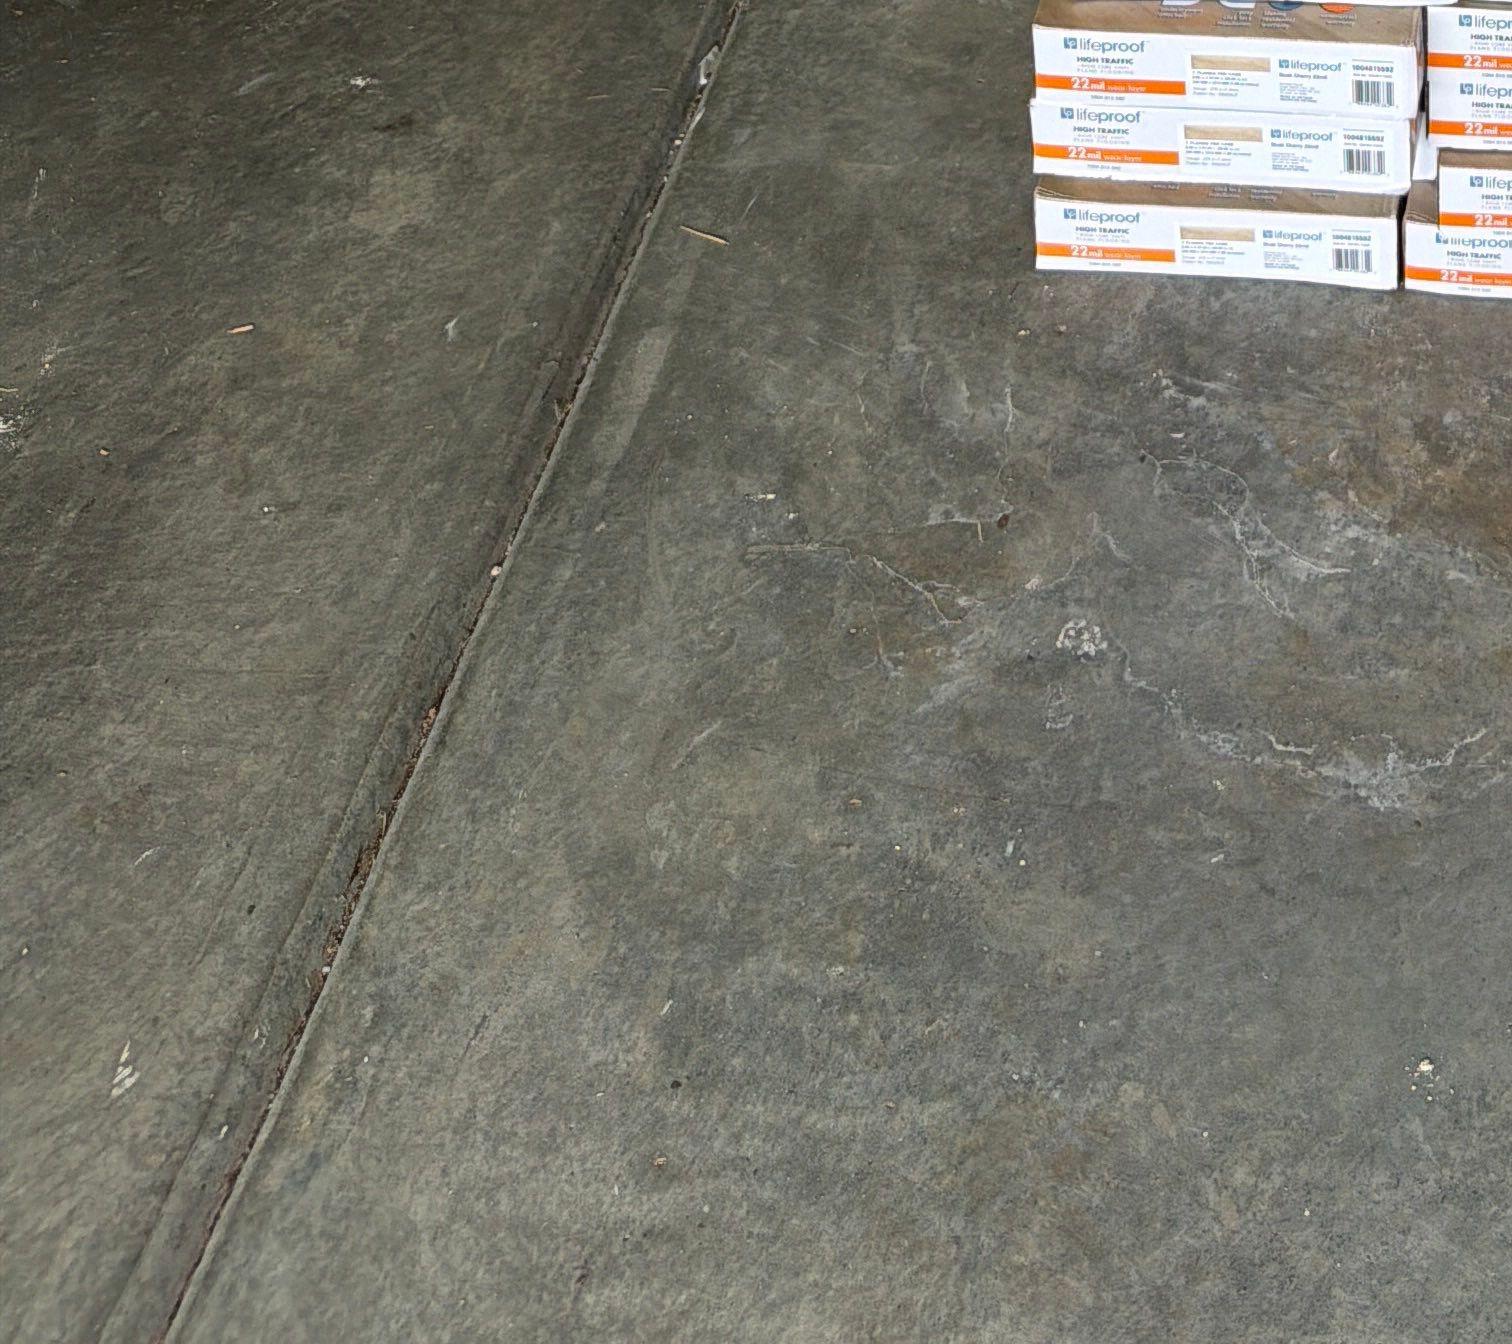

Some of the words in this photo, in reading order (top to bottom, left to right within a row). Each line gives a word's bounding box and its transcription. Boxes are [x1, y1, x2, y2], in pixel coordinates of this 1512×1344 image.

[1080, 39, 1145, 54] lifeproof
[1076, 109, 1141, 124] lifeproof
[1078, 210, 1141, 225] lifeproof
